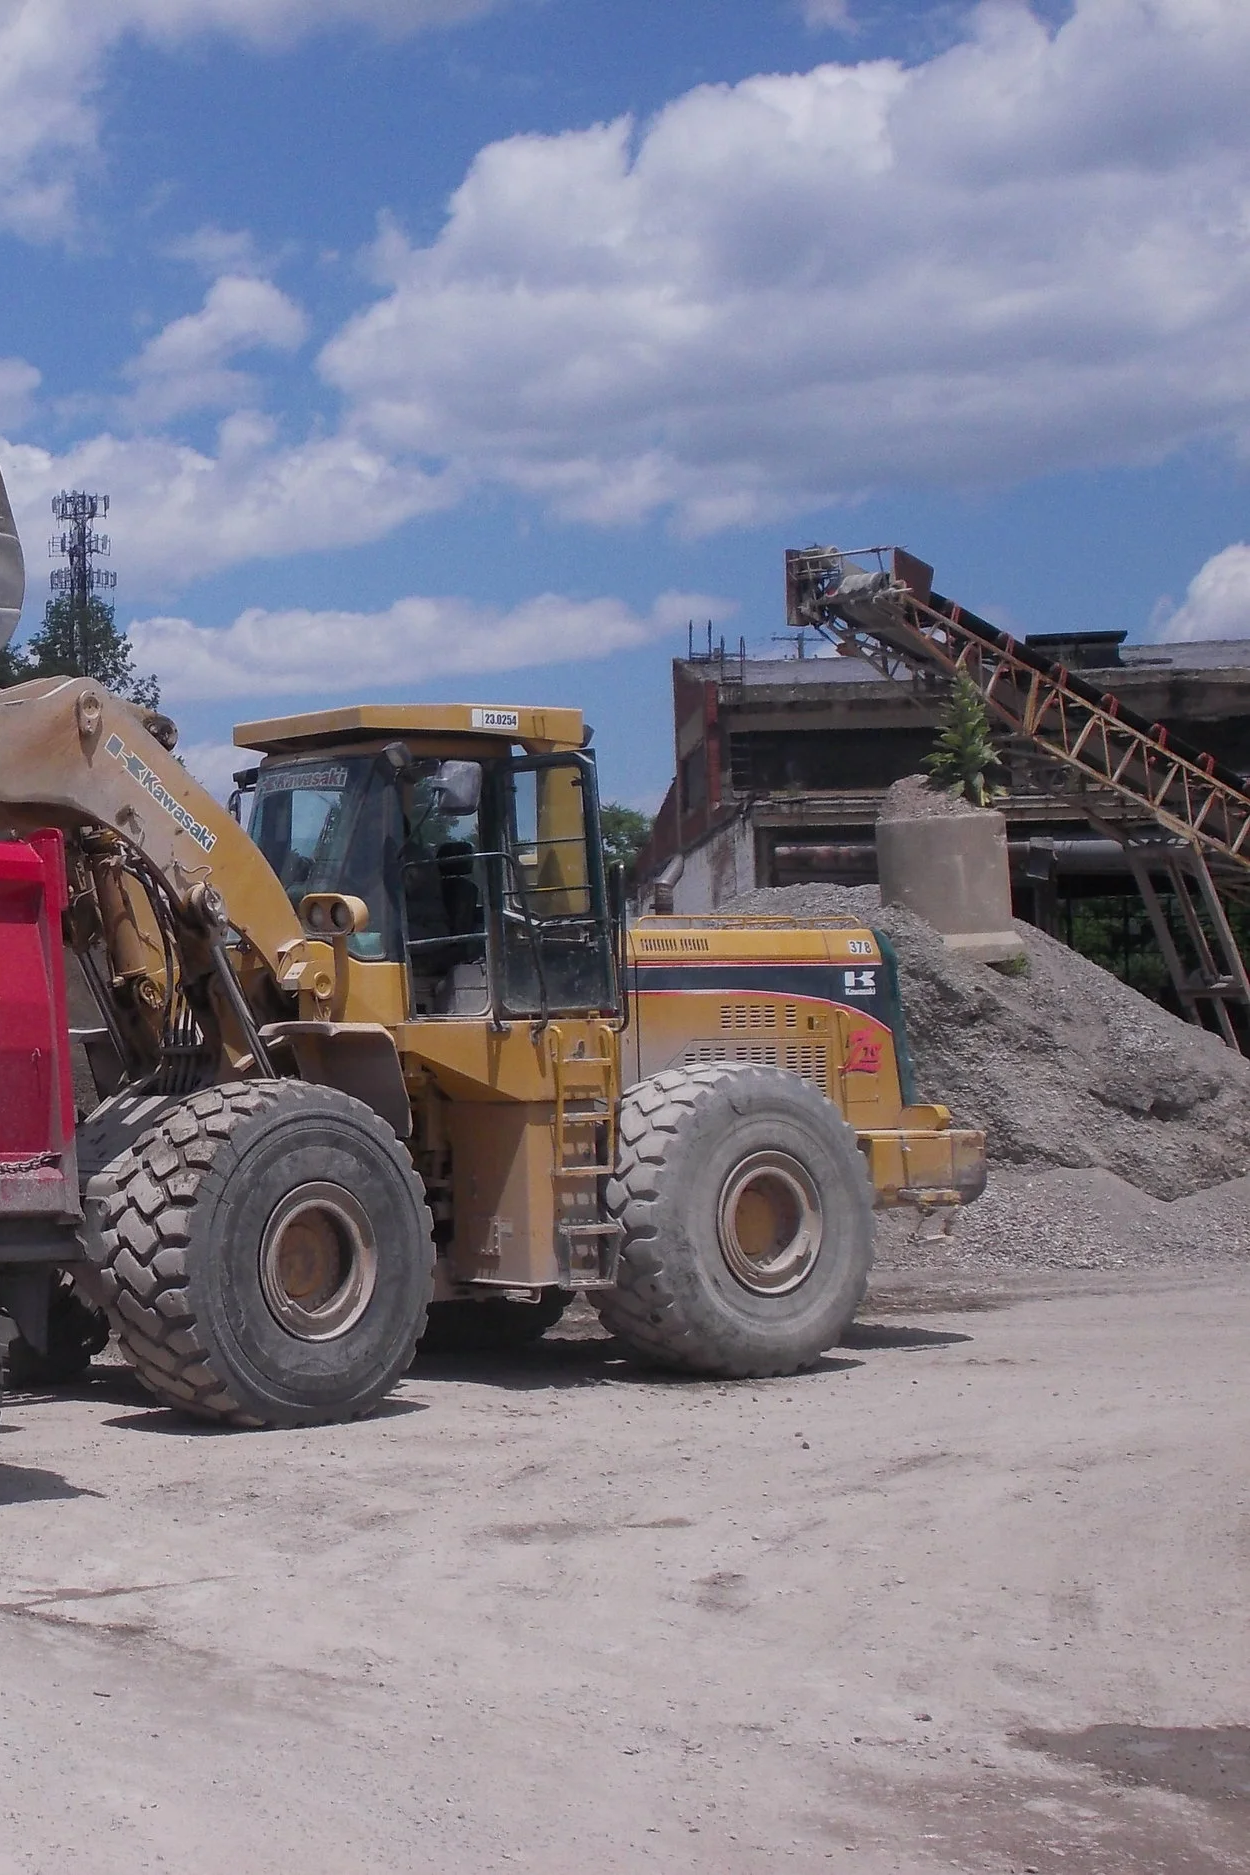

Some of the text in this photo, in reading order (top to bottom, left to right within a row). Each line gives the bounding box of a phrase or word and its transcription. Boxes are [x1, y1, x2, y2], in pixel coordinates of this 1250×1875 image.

[485, 713, 517, 726] 23.0254
[275, 767, 348, 790] Kawasaki
[141, 769, 217, 853] Kawasaki
[850, 941, 872, 953] 378
